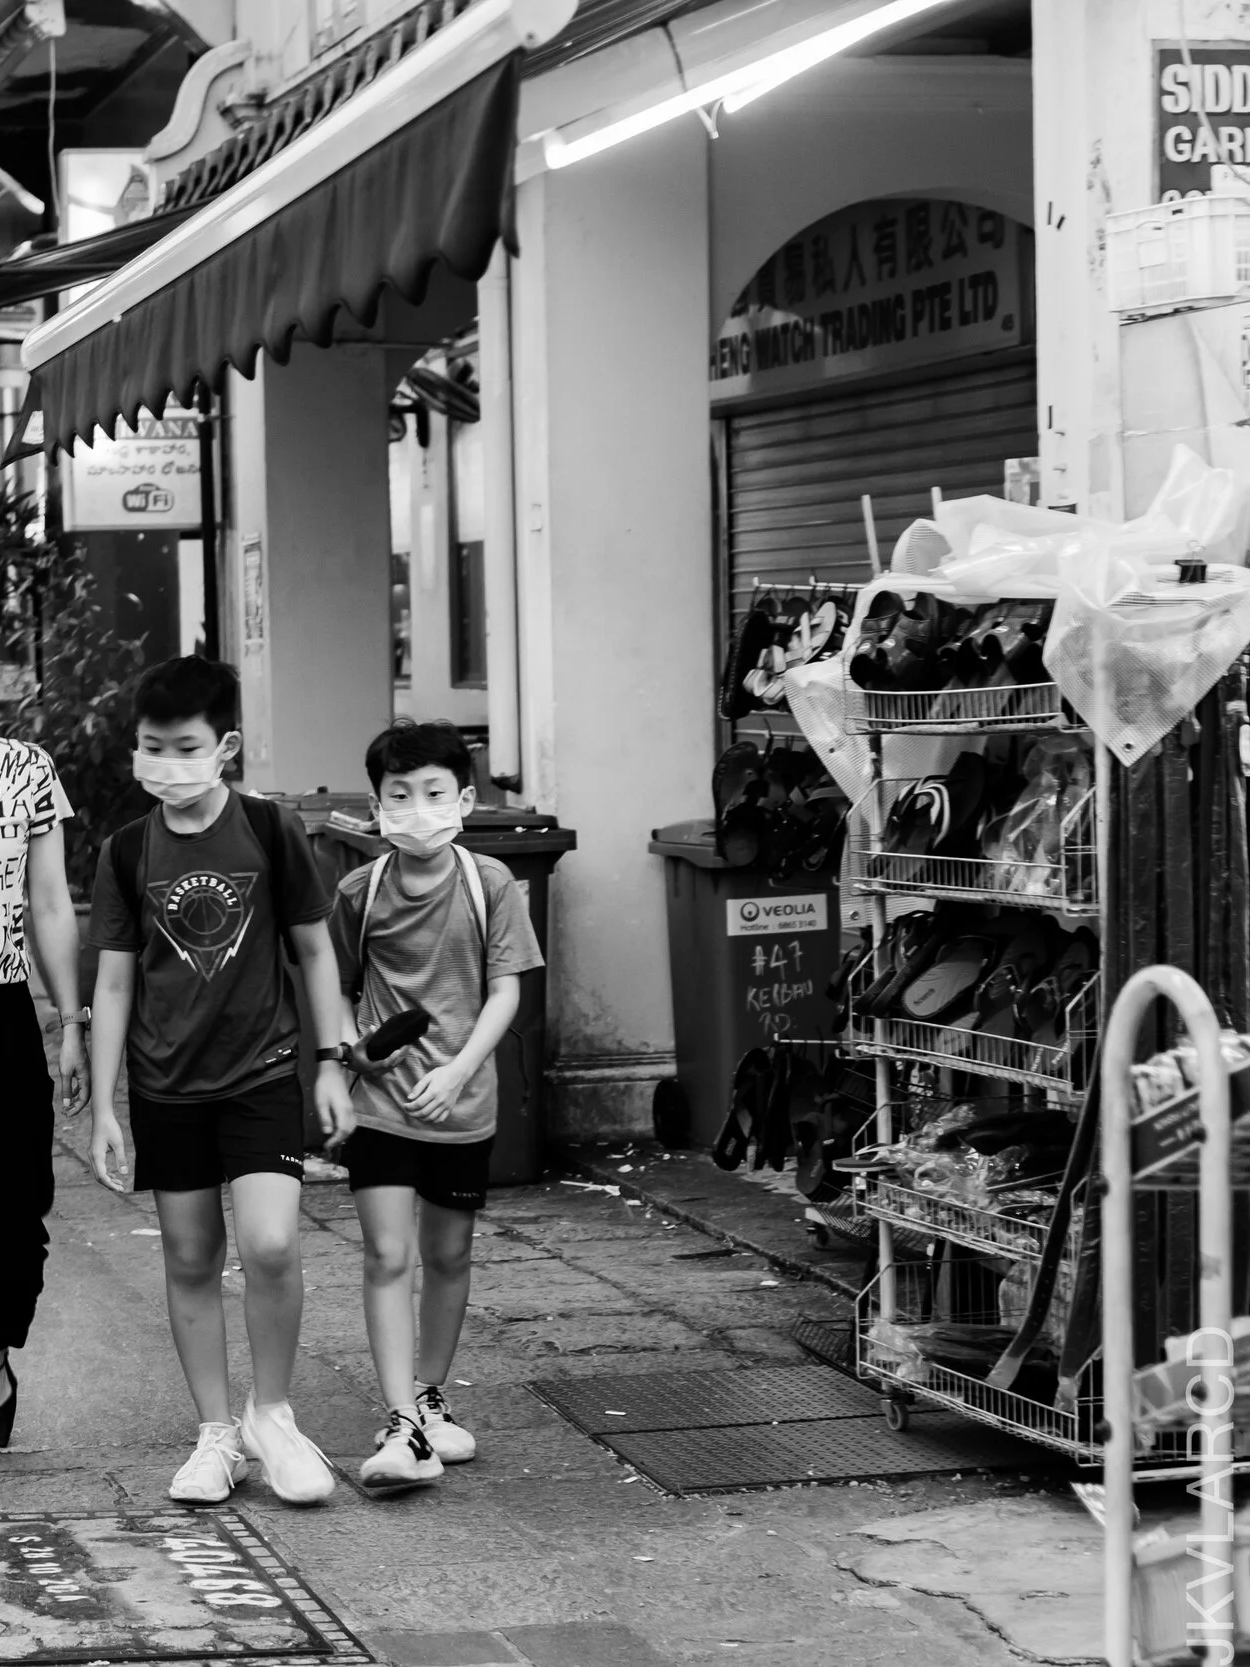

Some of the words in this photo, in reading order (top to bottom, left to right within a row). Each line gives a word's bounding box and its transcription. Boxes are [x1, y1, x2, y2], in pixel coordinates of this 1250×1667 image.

[755, 316, 816, 372] WATCH
[819, 292, 906, 358] TRADING
[912, 281, 952, 338] PTE
[166, 875, 238, 911] BASKETBALL
[762, 903, 816, 917] VEOLIA
[154, 1537, 283, 1608] 40468
